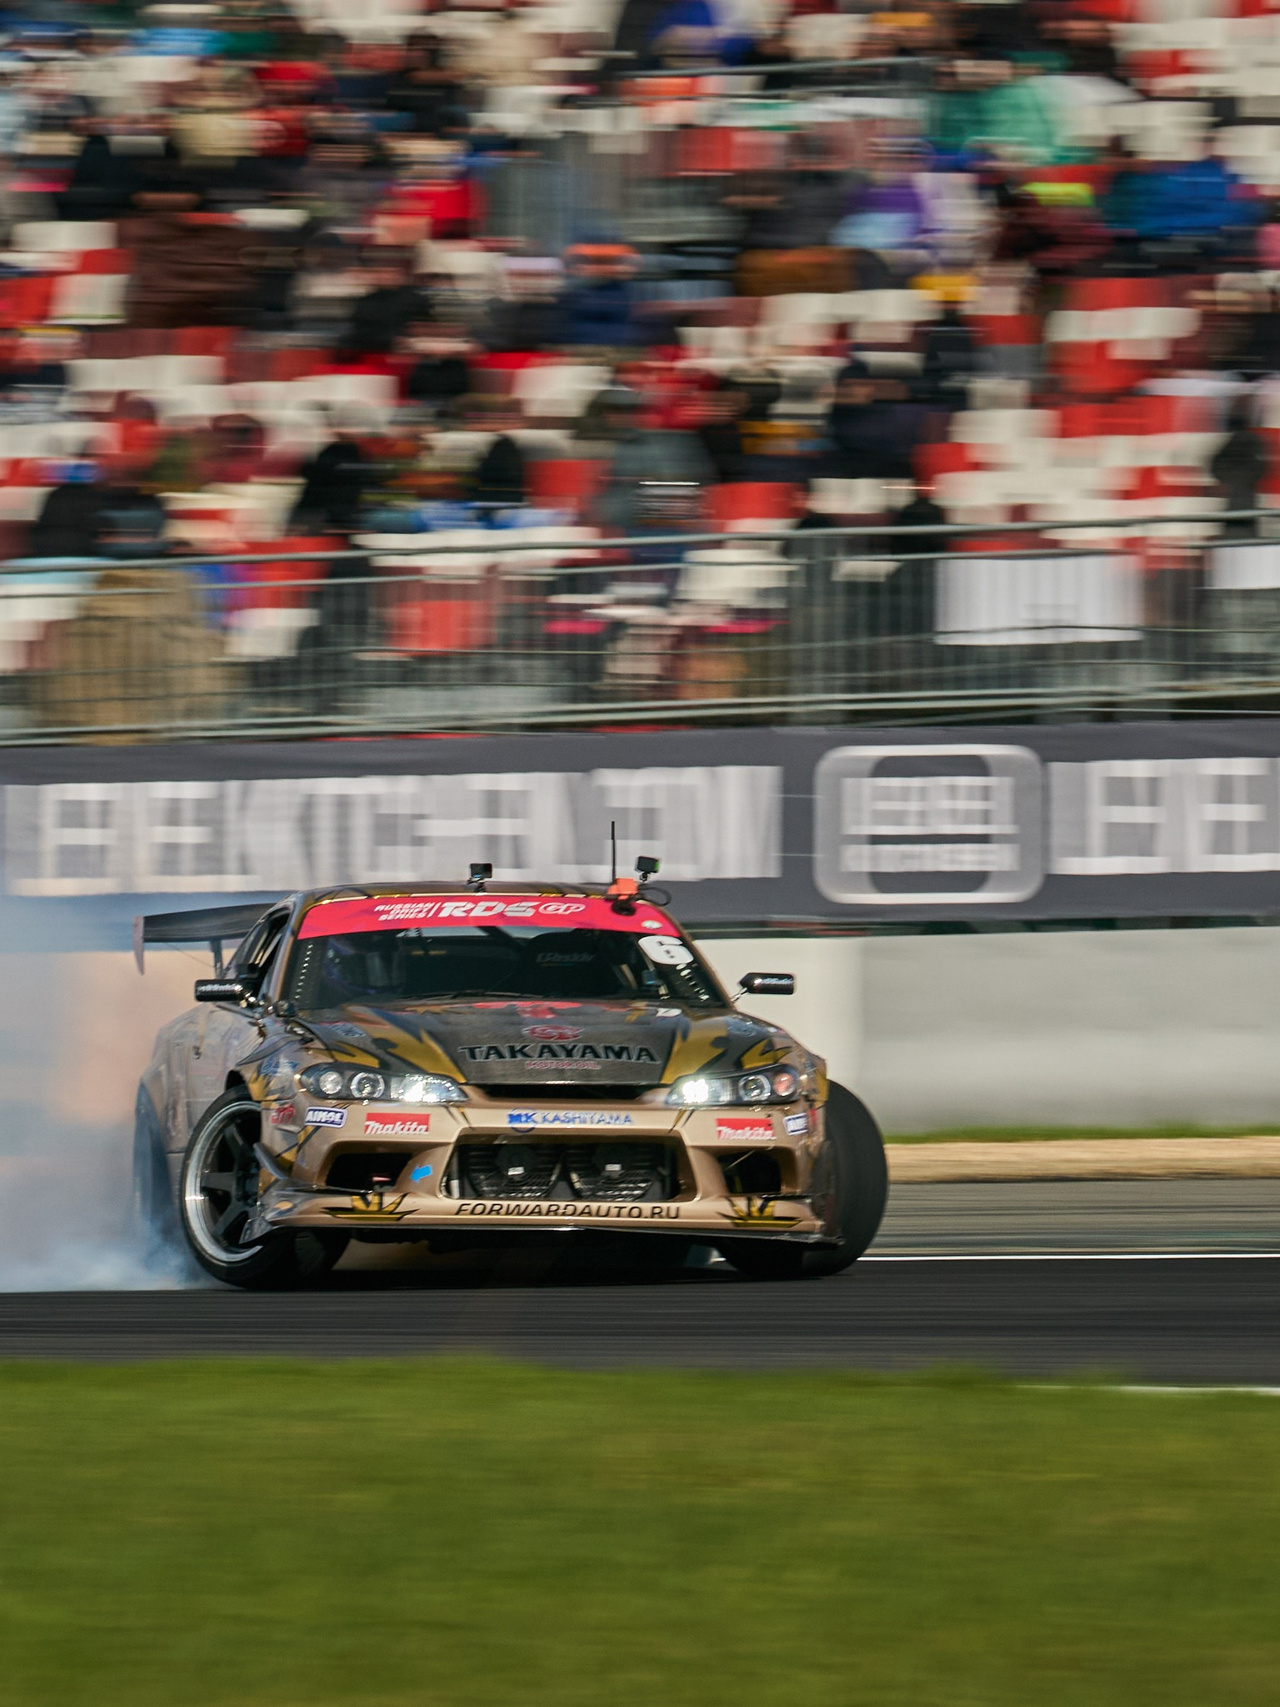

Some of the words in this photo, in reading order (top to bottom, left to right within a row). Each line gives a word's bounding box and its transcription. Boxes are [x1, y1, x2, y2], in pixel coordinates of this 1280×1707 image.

[437, 901, 540, 918] RDS
[638, 935, 694, 965] 6
[458, 1042, 662, 1064] TAKAYAMA
[540, 1112, 634, 1125] KASHIYAMA
[364, 1121, 430, 1135] Makita
[455, 1202, 680, 1220] FORWARDAUTO.RU
